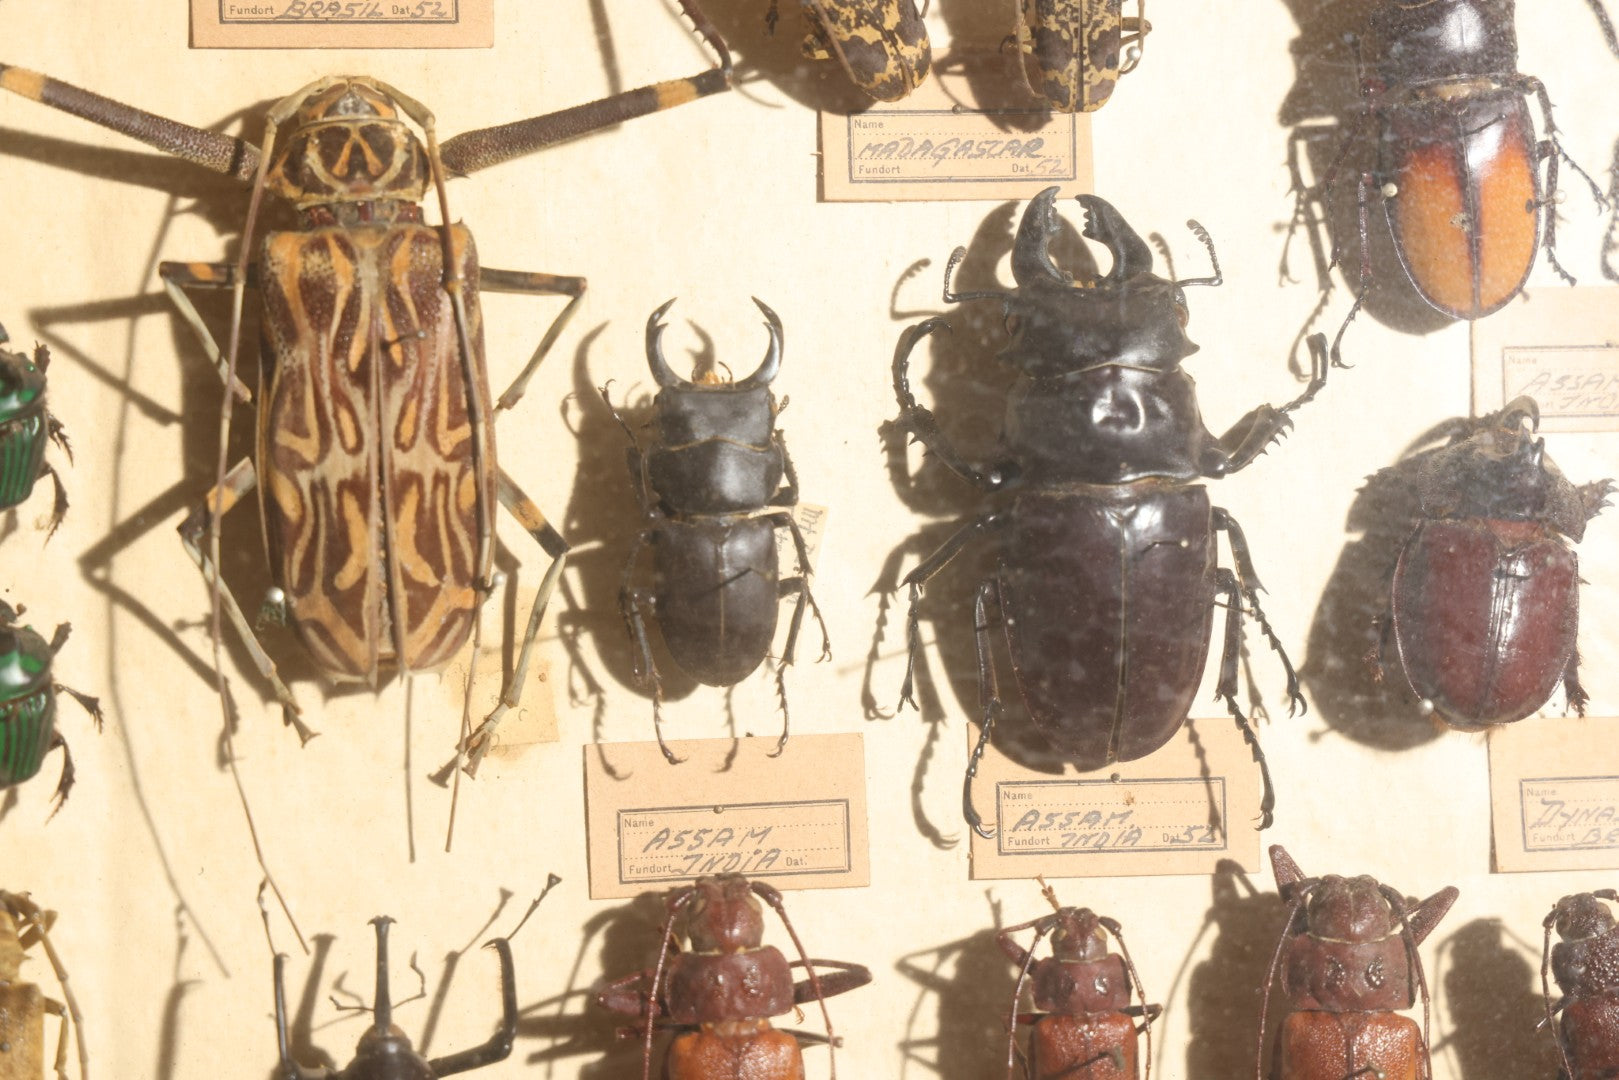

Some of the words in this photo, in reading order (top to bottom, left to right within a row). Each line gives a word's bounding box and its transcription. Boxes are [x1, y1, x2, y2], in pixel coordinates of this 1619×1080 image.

[229, 5, 275, 15] Fundort
[276, 0, 384, 19] BRASIL
[410, 1, 447, 18] 52
[854, 119, 884, 129] Name
[858, 164, 901, 175] Fundort
[1003, 790, 1033, 800] Name
[1526, 787, 1557, 797] Name
[1528, 798, 1619, 832] DYNA
[624, 818, 654, 828] Name
[643, 826, 773, 853] ASSAM
[1007, 836, 1051, 847] Fundort
[1533, 832, 1576, 843] Fundort
[629, 863, 672, 875] Fundort
